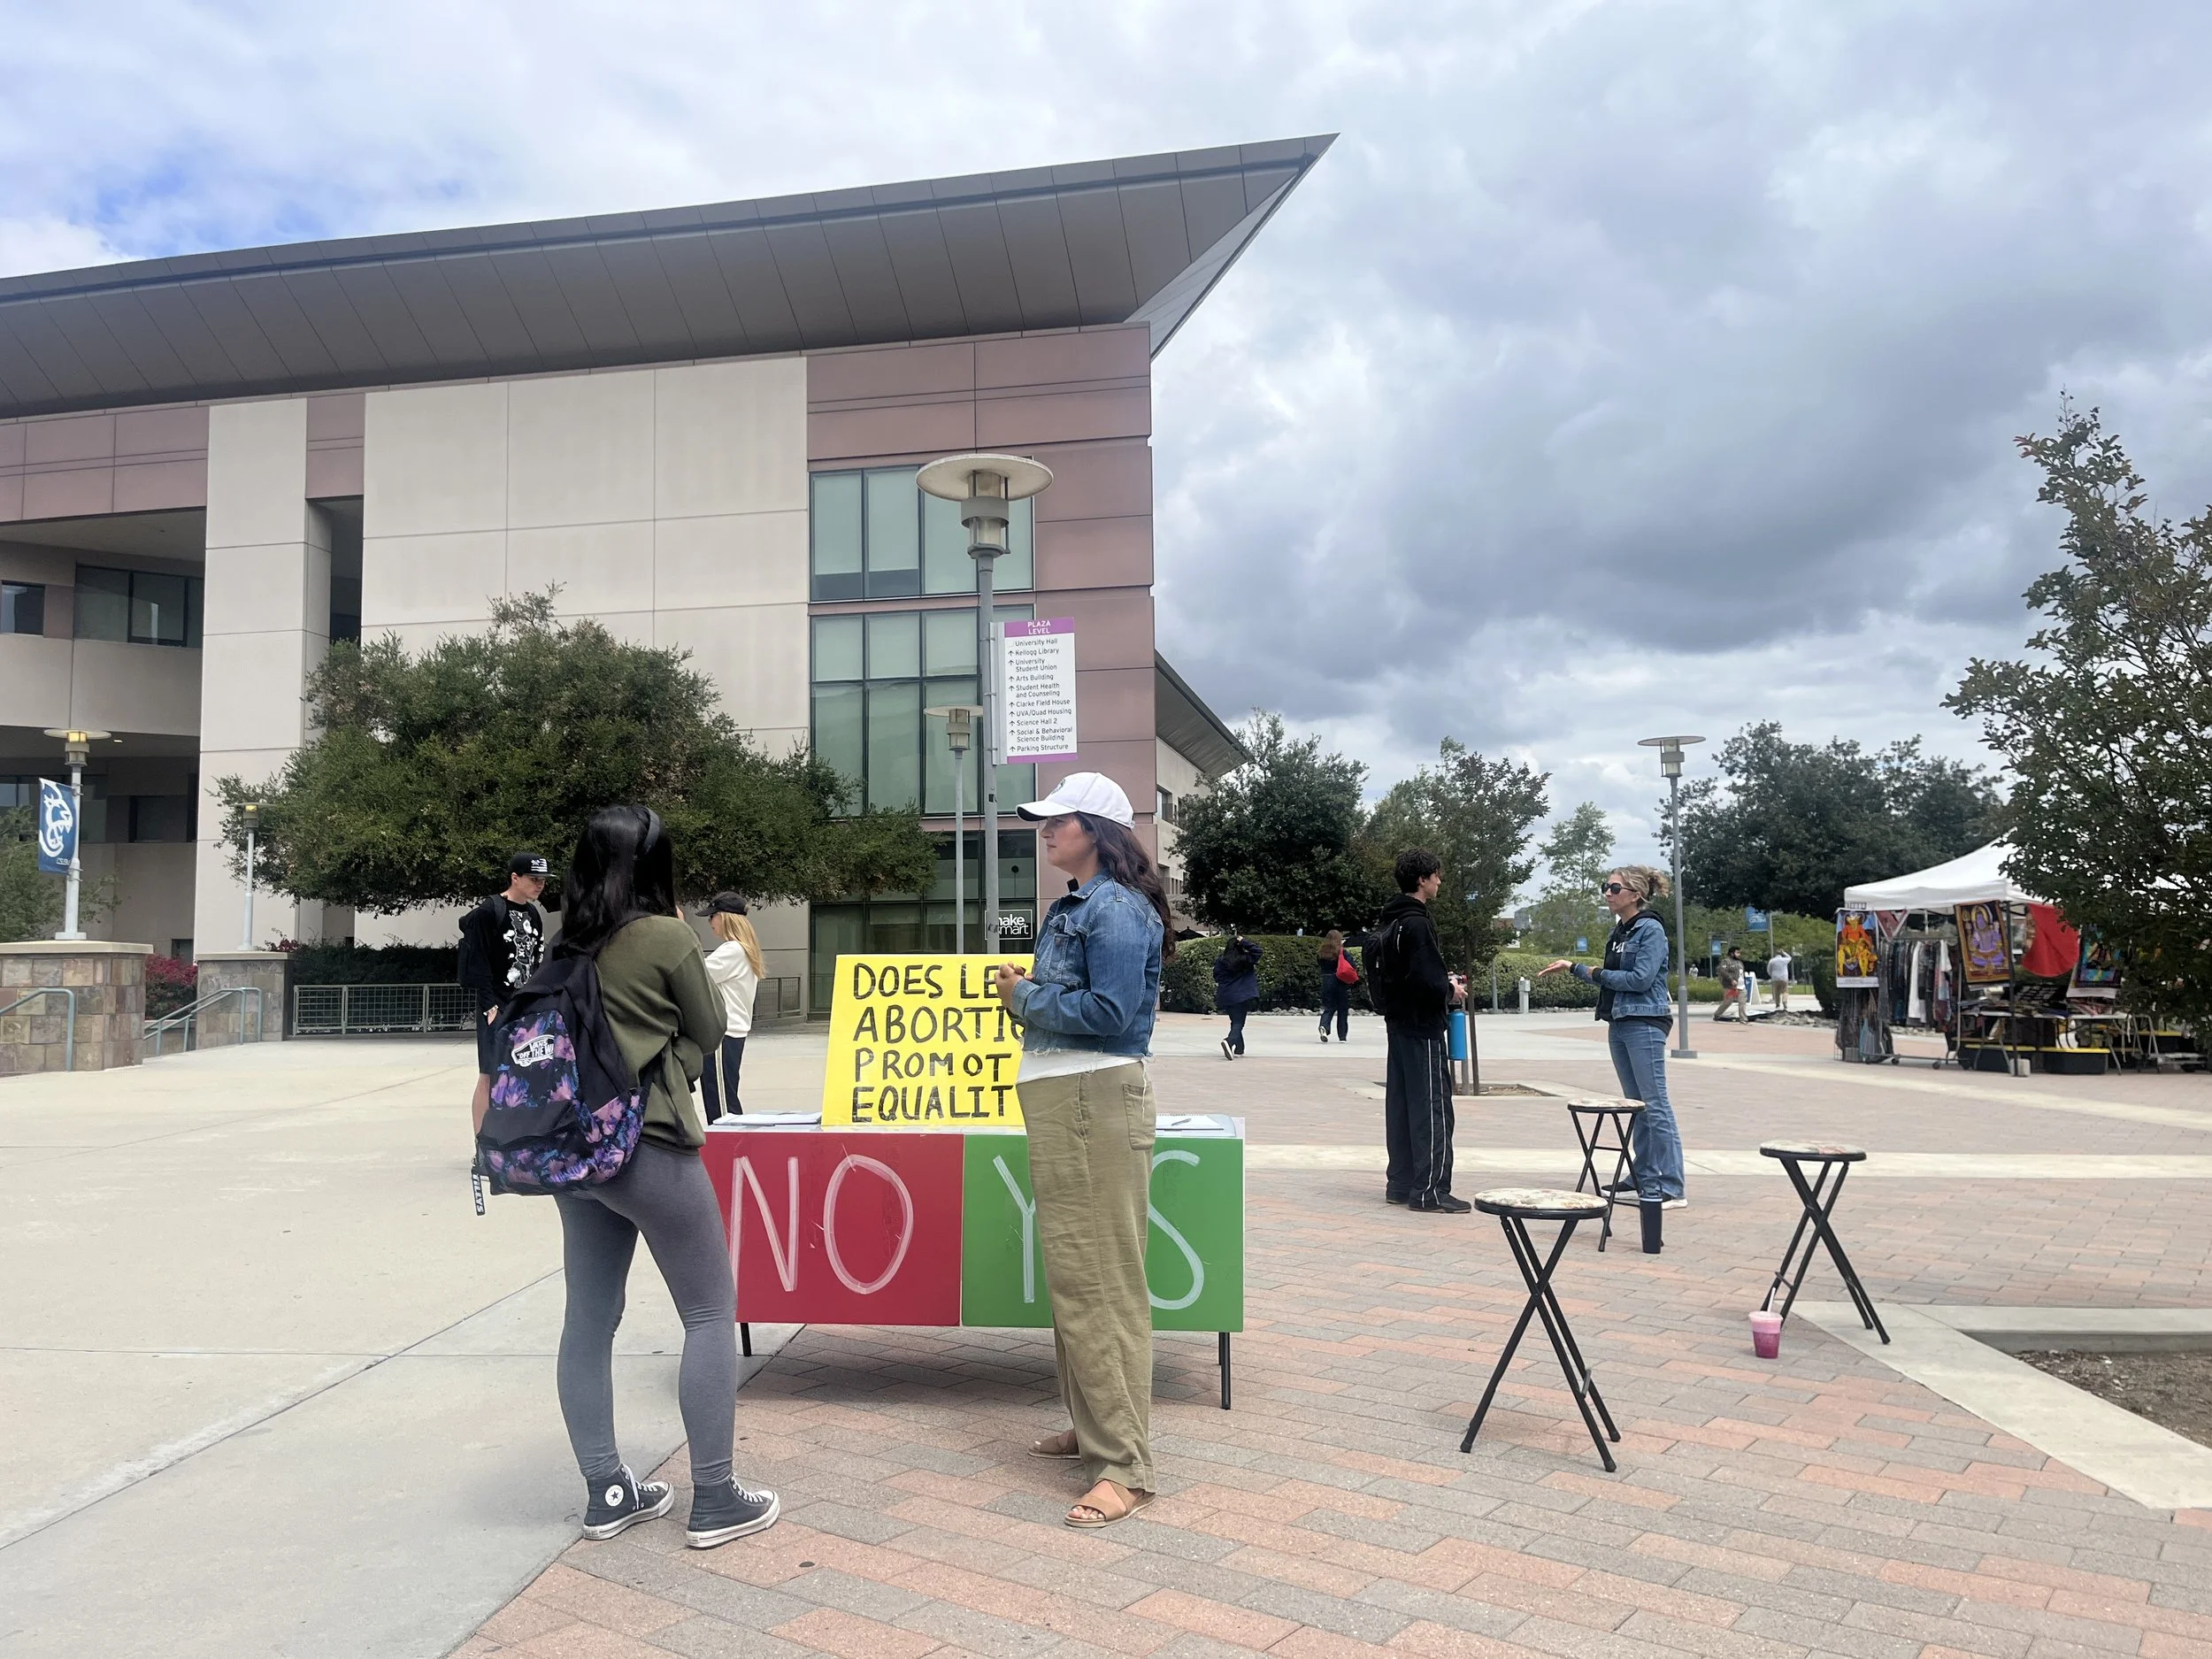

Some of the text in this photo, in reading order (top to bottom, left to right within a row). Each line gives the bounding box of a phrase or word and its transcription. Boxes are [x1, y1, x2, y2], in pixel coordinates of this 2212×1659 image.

[999, 924, 1029, 934] mart
[853, 963, 1001, 1000] DOES LE
[531, 1046, 545, 1058] THE
[532, 1039, 549, 1048] VANS
[855, 1047, 1012, 1082] PROMOT
[851, 1085, 1014, 1123] EQUALIT
[472, 1173, 484, 1212] TILLYS
[730, 1154, 914, 1294] NO
[993, 1149, 1204, 1310] YS
